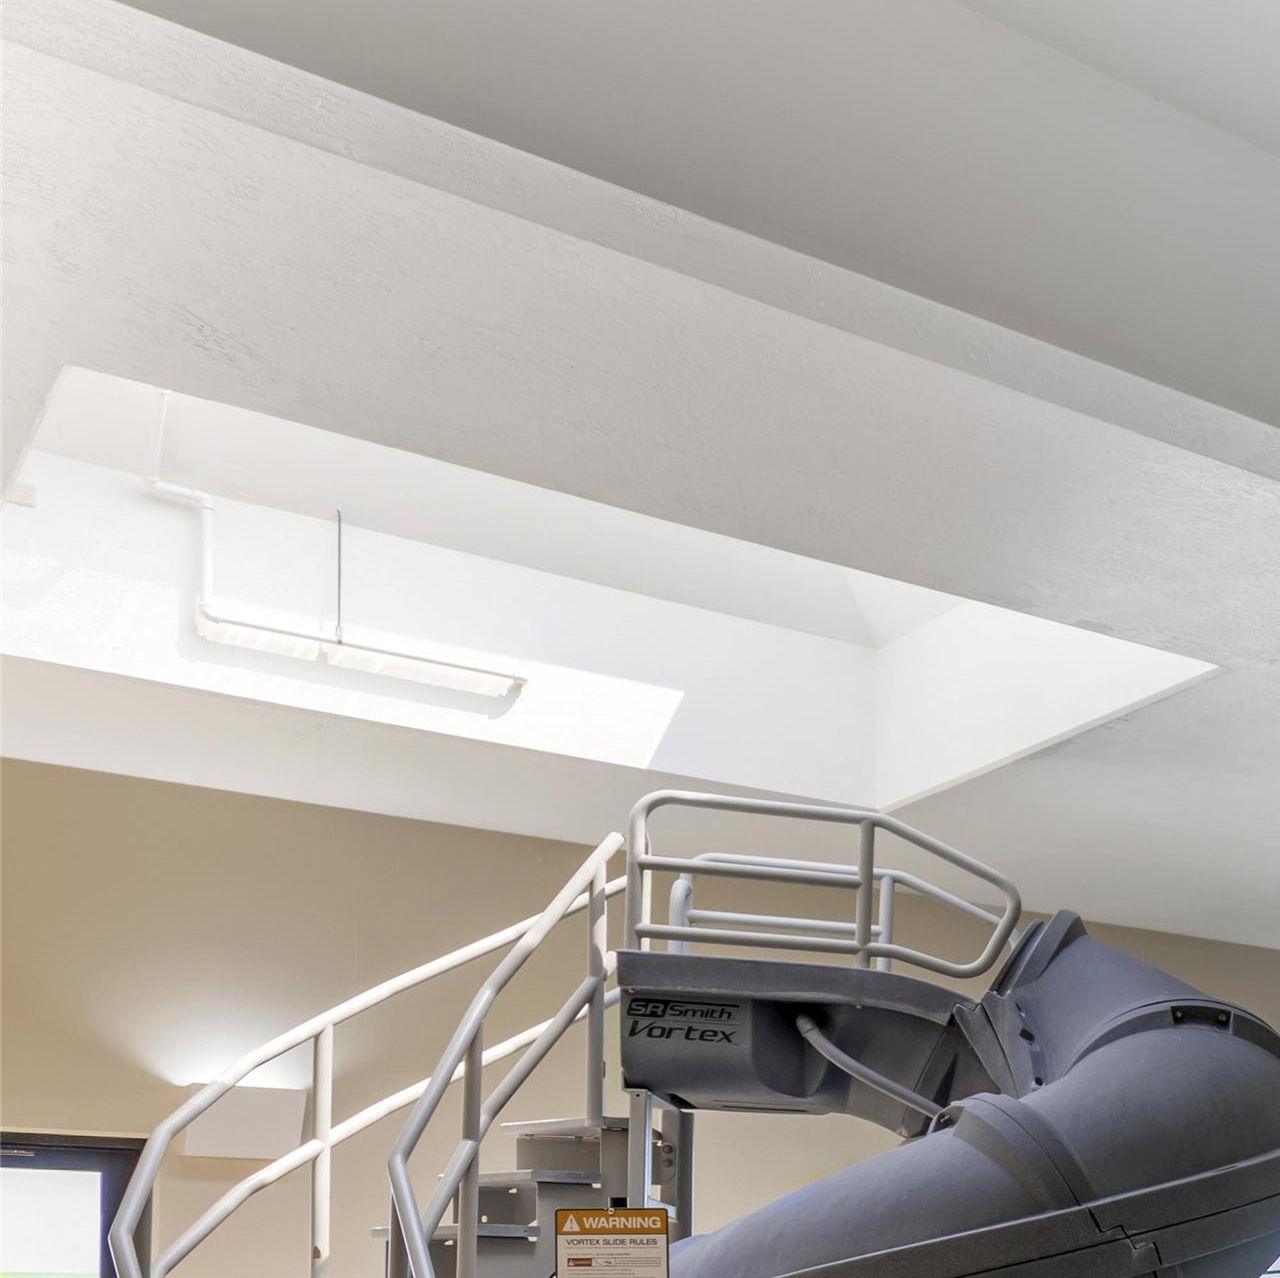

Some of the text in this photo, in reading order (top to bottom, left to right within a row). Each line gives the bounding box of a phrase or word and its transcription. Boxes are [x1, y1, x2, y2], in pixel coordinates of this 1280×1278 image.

[629, 1000, 734, 1020] SR Smith
[628, 1019, 737, 1044] Vortex
[583, 1216, 662, 1229] WARNING
[566, 1238, 658, 1246] VORTEX SLIDE RULES
